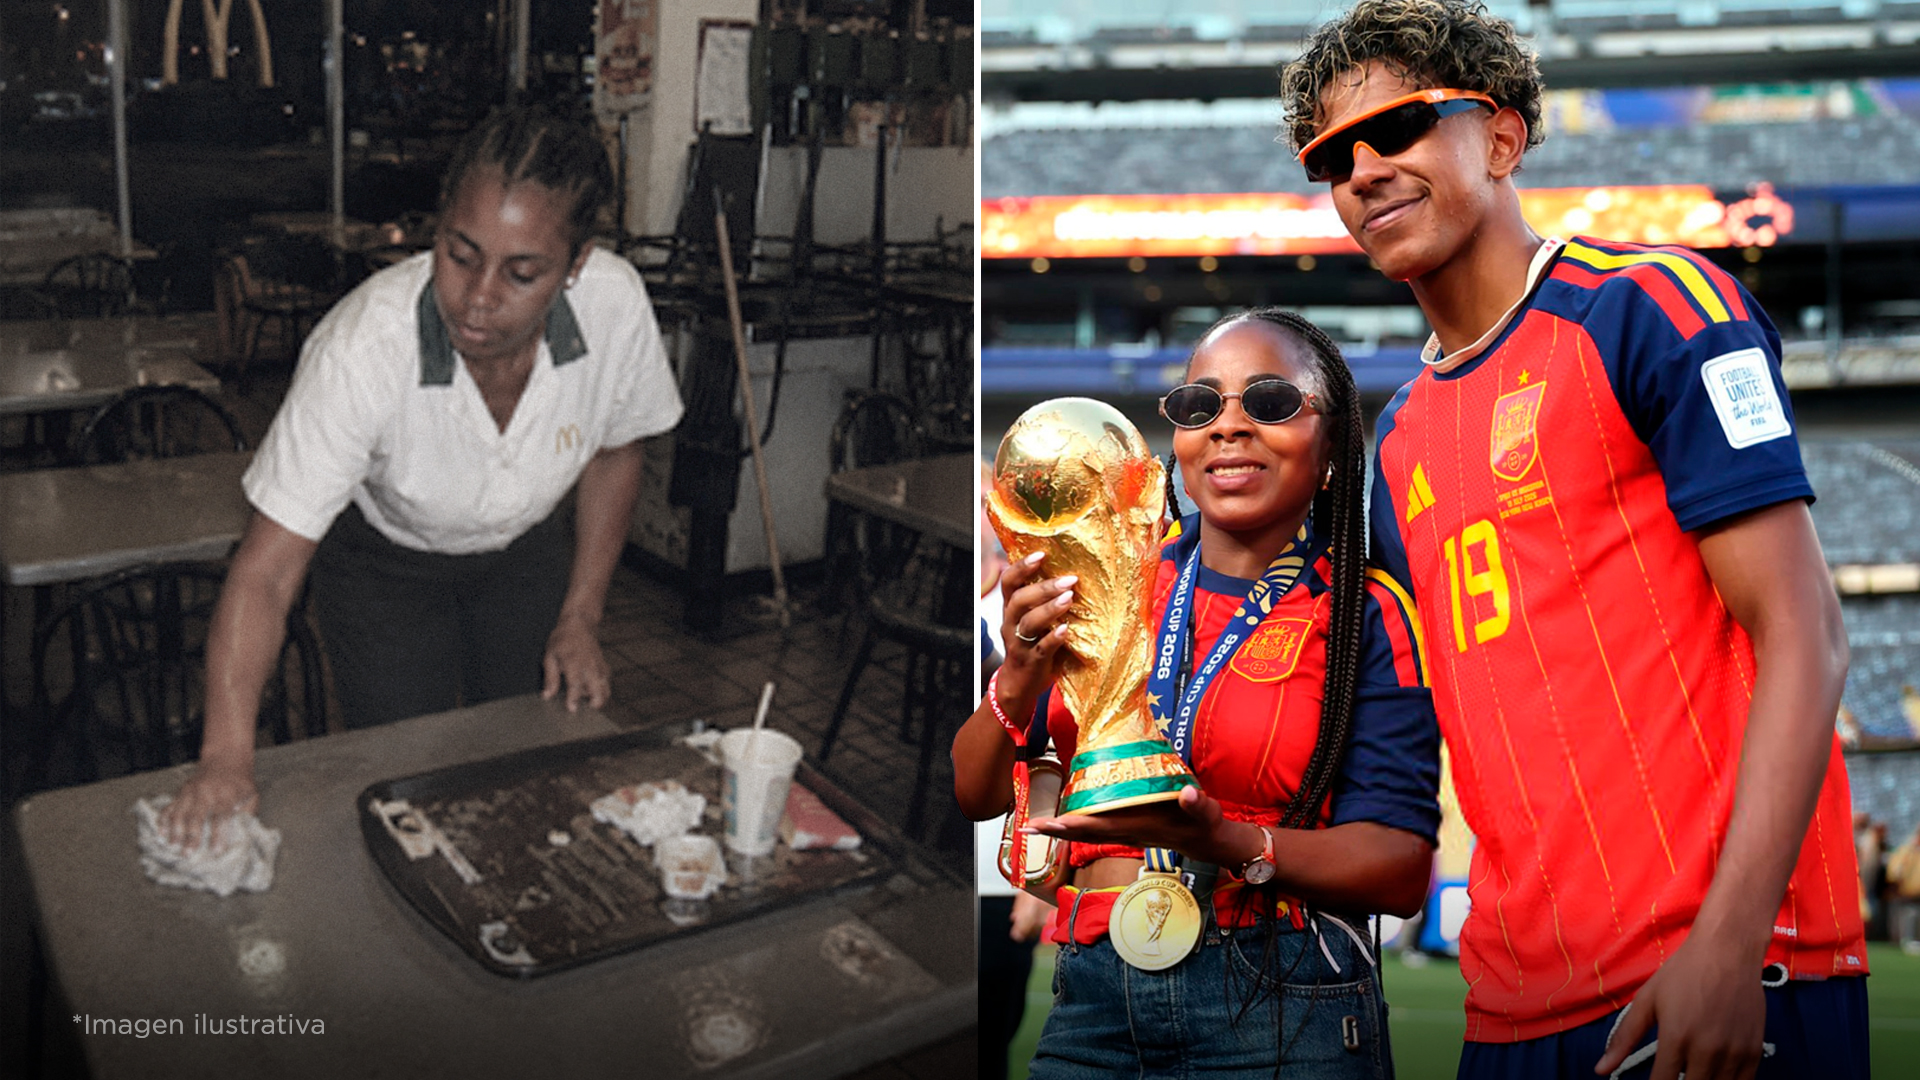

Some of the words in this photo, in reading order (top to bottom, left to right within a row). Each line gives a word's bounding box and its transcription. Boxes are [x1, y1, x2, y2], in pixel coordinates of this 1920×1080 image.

[1174, 563, 1193, 607] WORLD
[1444, 519, 1510, 653] 19
[1167, 607, 1183, 632] CUP
[1157, 633, 1178, 680] 2026
[1174, 705, 1191, 757] ORLD
[1186, 676, 1204, 704] CUP
[1202, 632, 1239, 675] 2026
